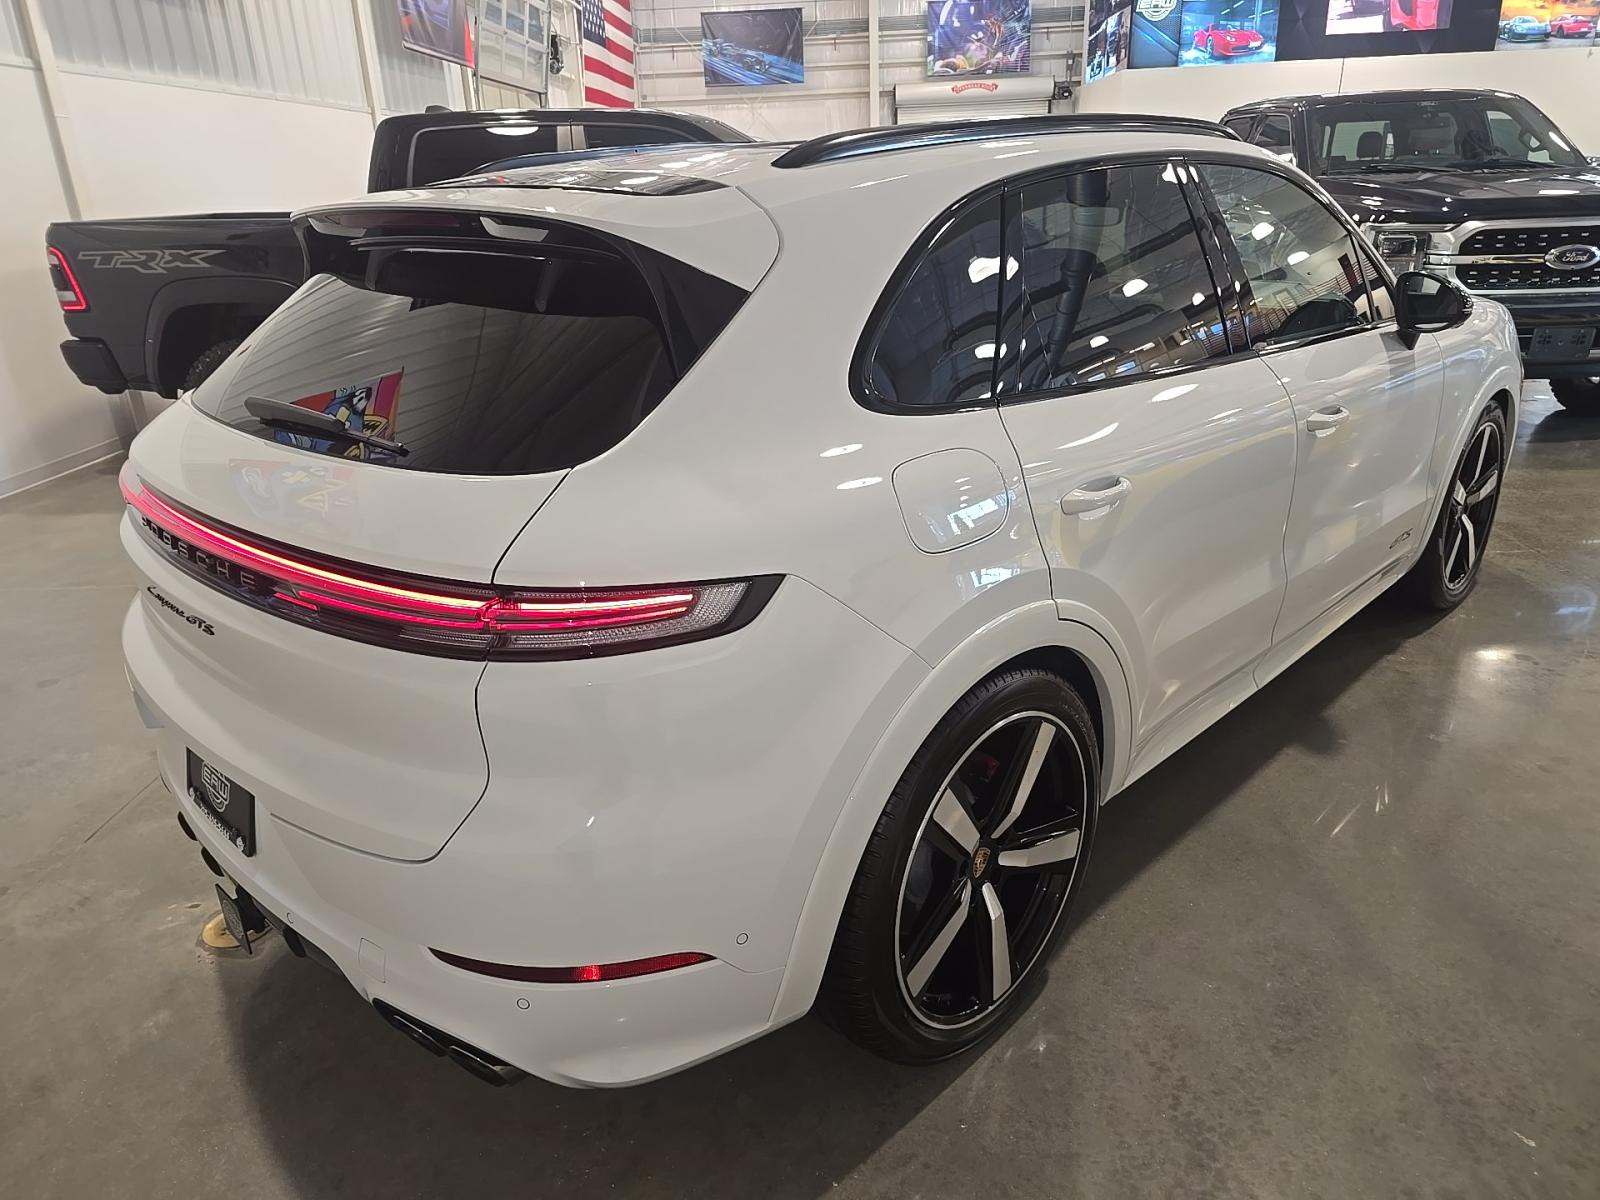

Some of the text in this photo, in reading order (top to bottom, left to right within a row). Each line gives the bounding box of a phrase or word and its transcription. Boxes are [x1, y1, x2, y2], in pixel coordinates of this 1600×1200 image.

[78, 250, 226, 273] TRX
[1562, 251, 1590, 262] Ford
[1389, 527, 1413, 549] GTS
[185, 615, 215, 635] GTS
